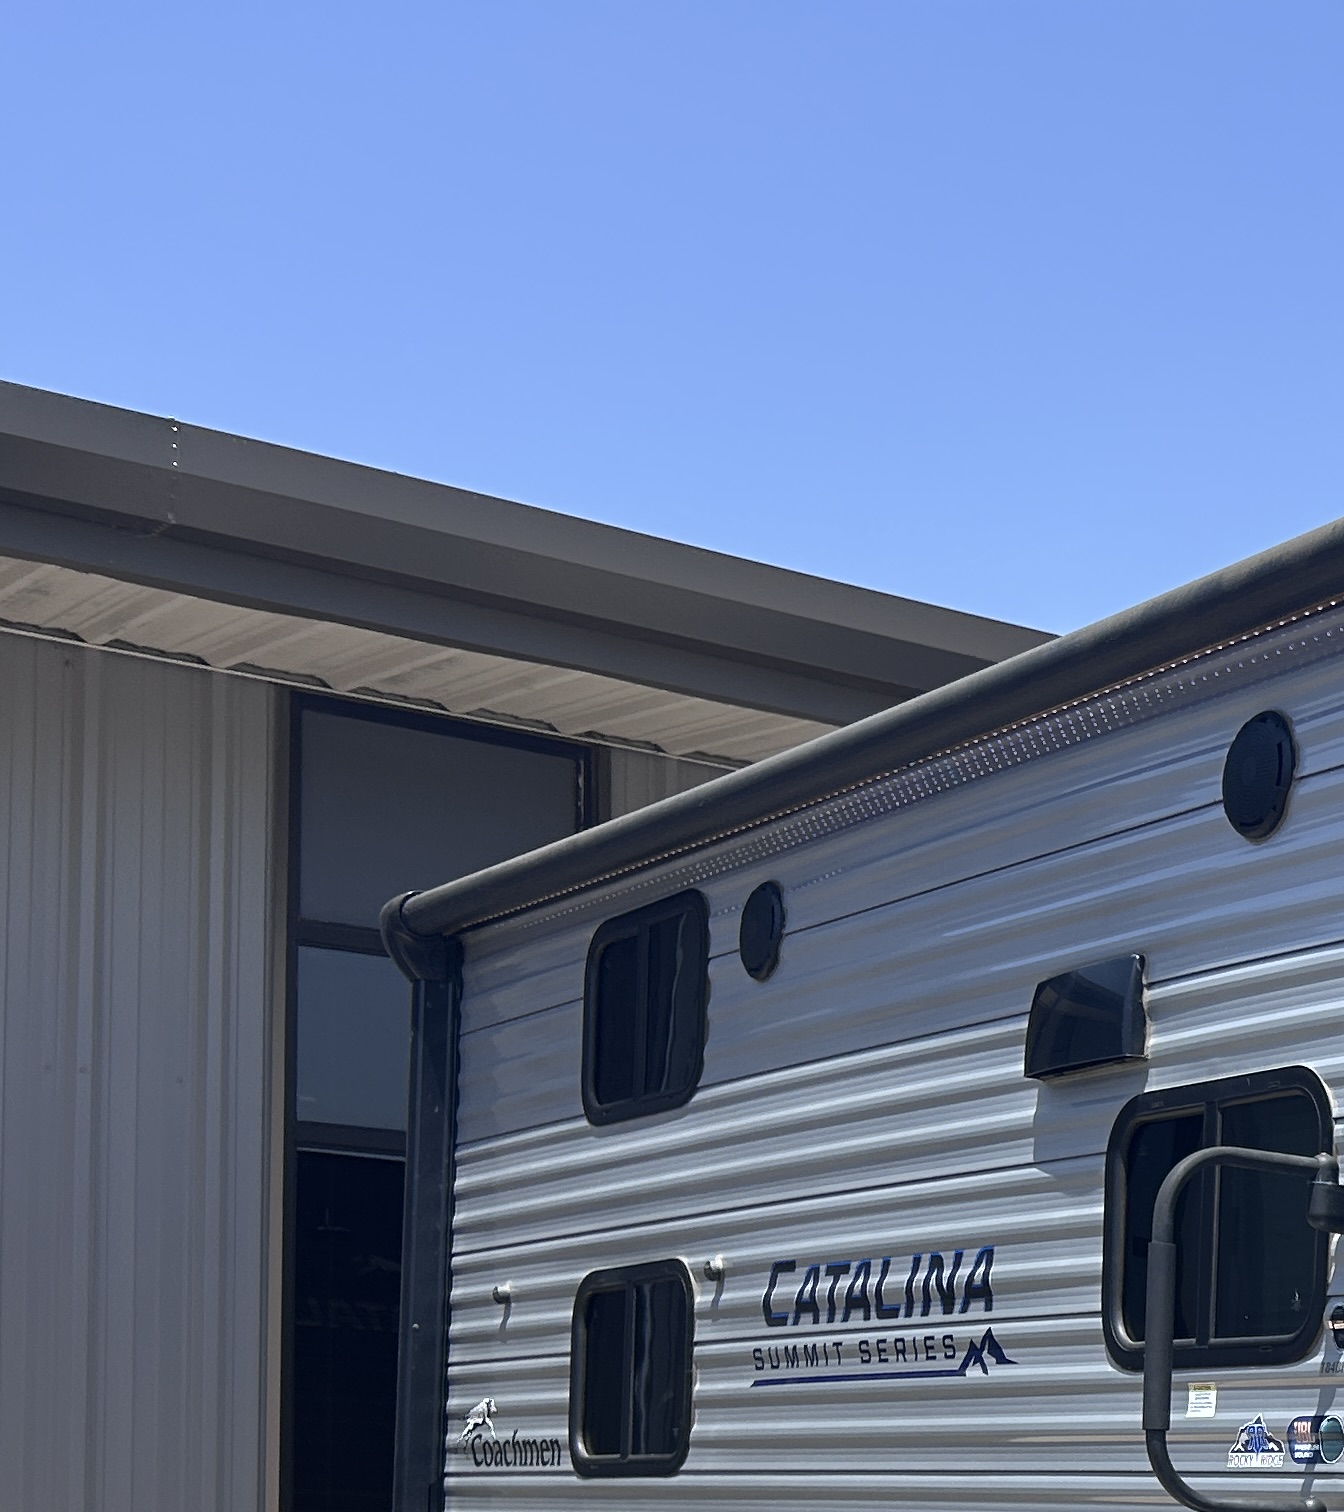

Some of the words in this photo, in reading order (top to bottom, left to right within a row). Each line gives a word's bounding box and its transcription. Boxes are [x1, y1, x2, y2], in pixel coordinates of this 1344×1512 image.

[762, 1244, 995, 1328] CATALINA
[752, 1340, 844, 1372] SUMMIT
[857, 1333, 957, 1365] SERIES
[470, 1427, 562, 1468] Coachmen
